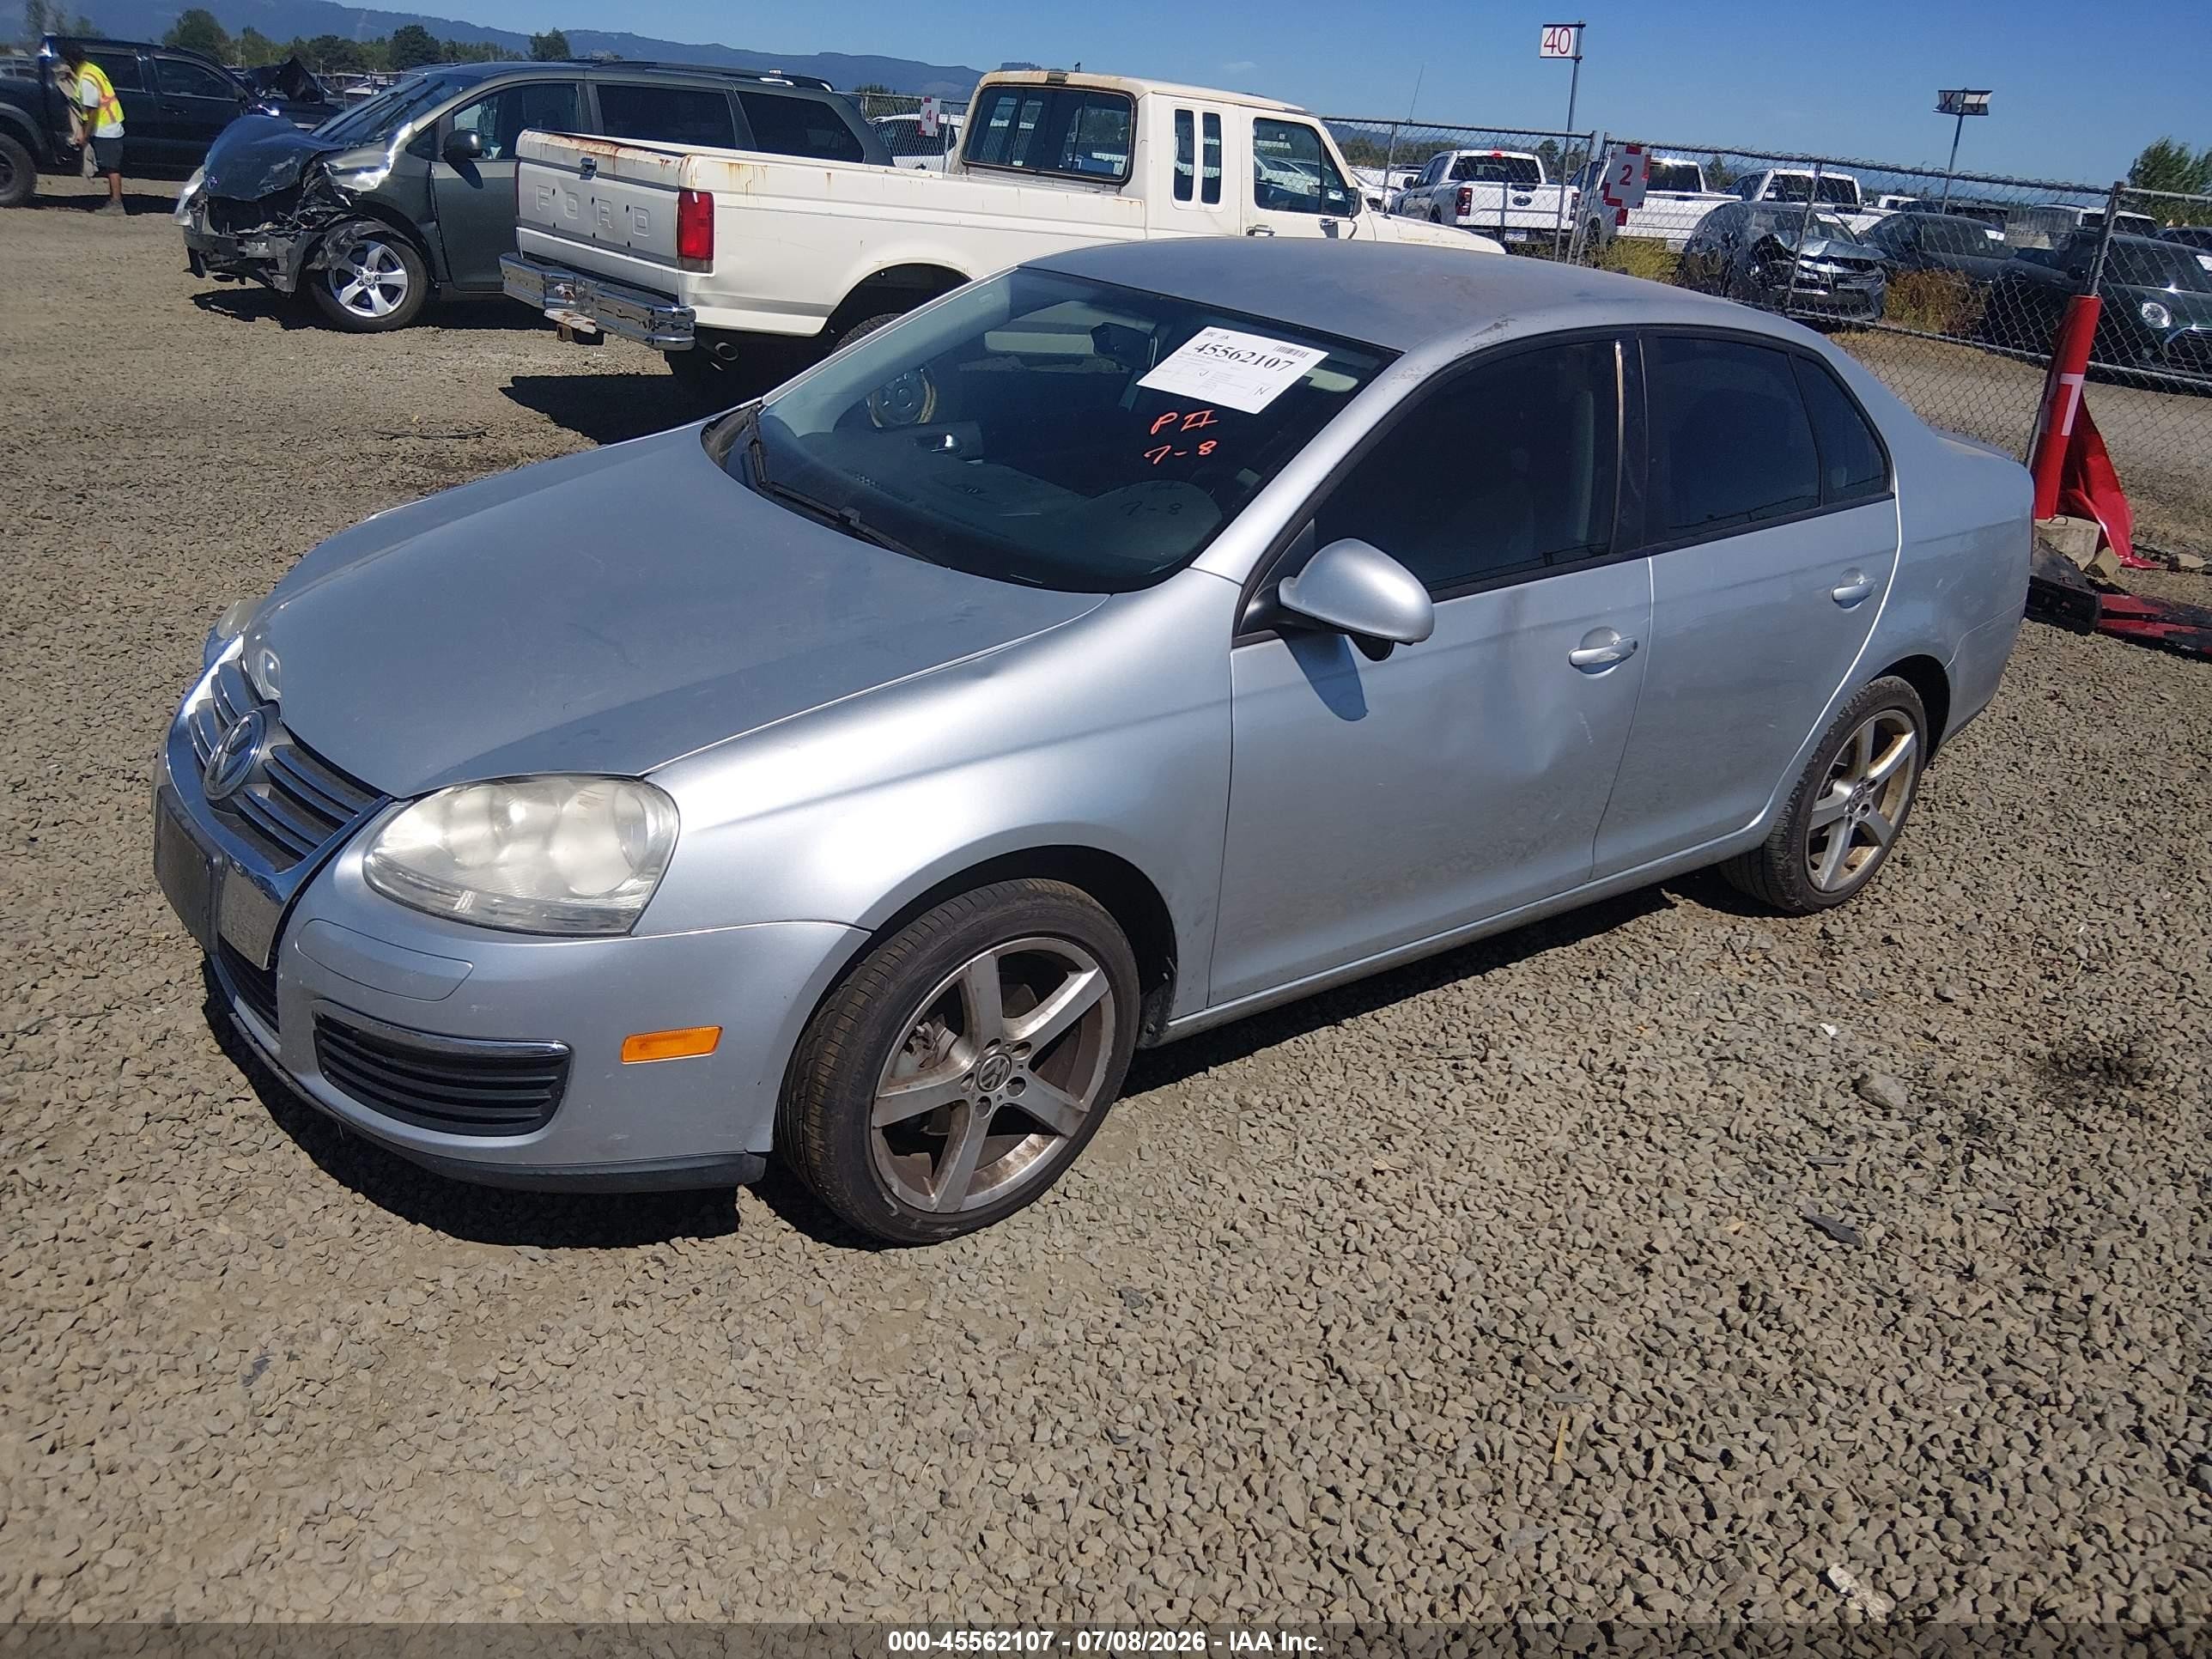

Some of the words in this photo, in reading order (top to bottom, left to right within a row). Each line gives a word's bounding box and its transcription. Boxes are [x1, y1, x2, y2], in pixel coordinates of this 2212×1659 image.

[1543, 27, 1571, 55] 40
[926, 109, 933, 123] 4
[1619, 164, 1633, 186] 2
[536, 185, 650, 236] FORD
[1194, 342, 1296, 372] 45562107
